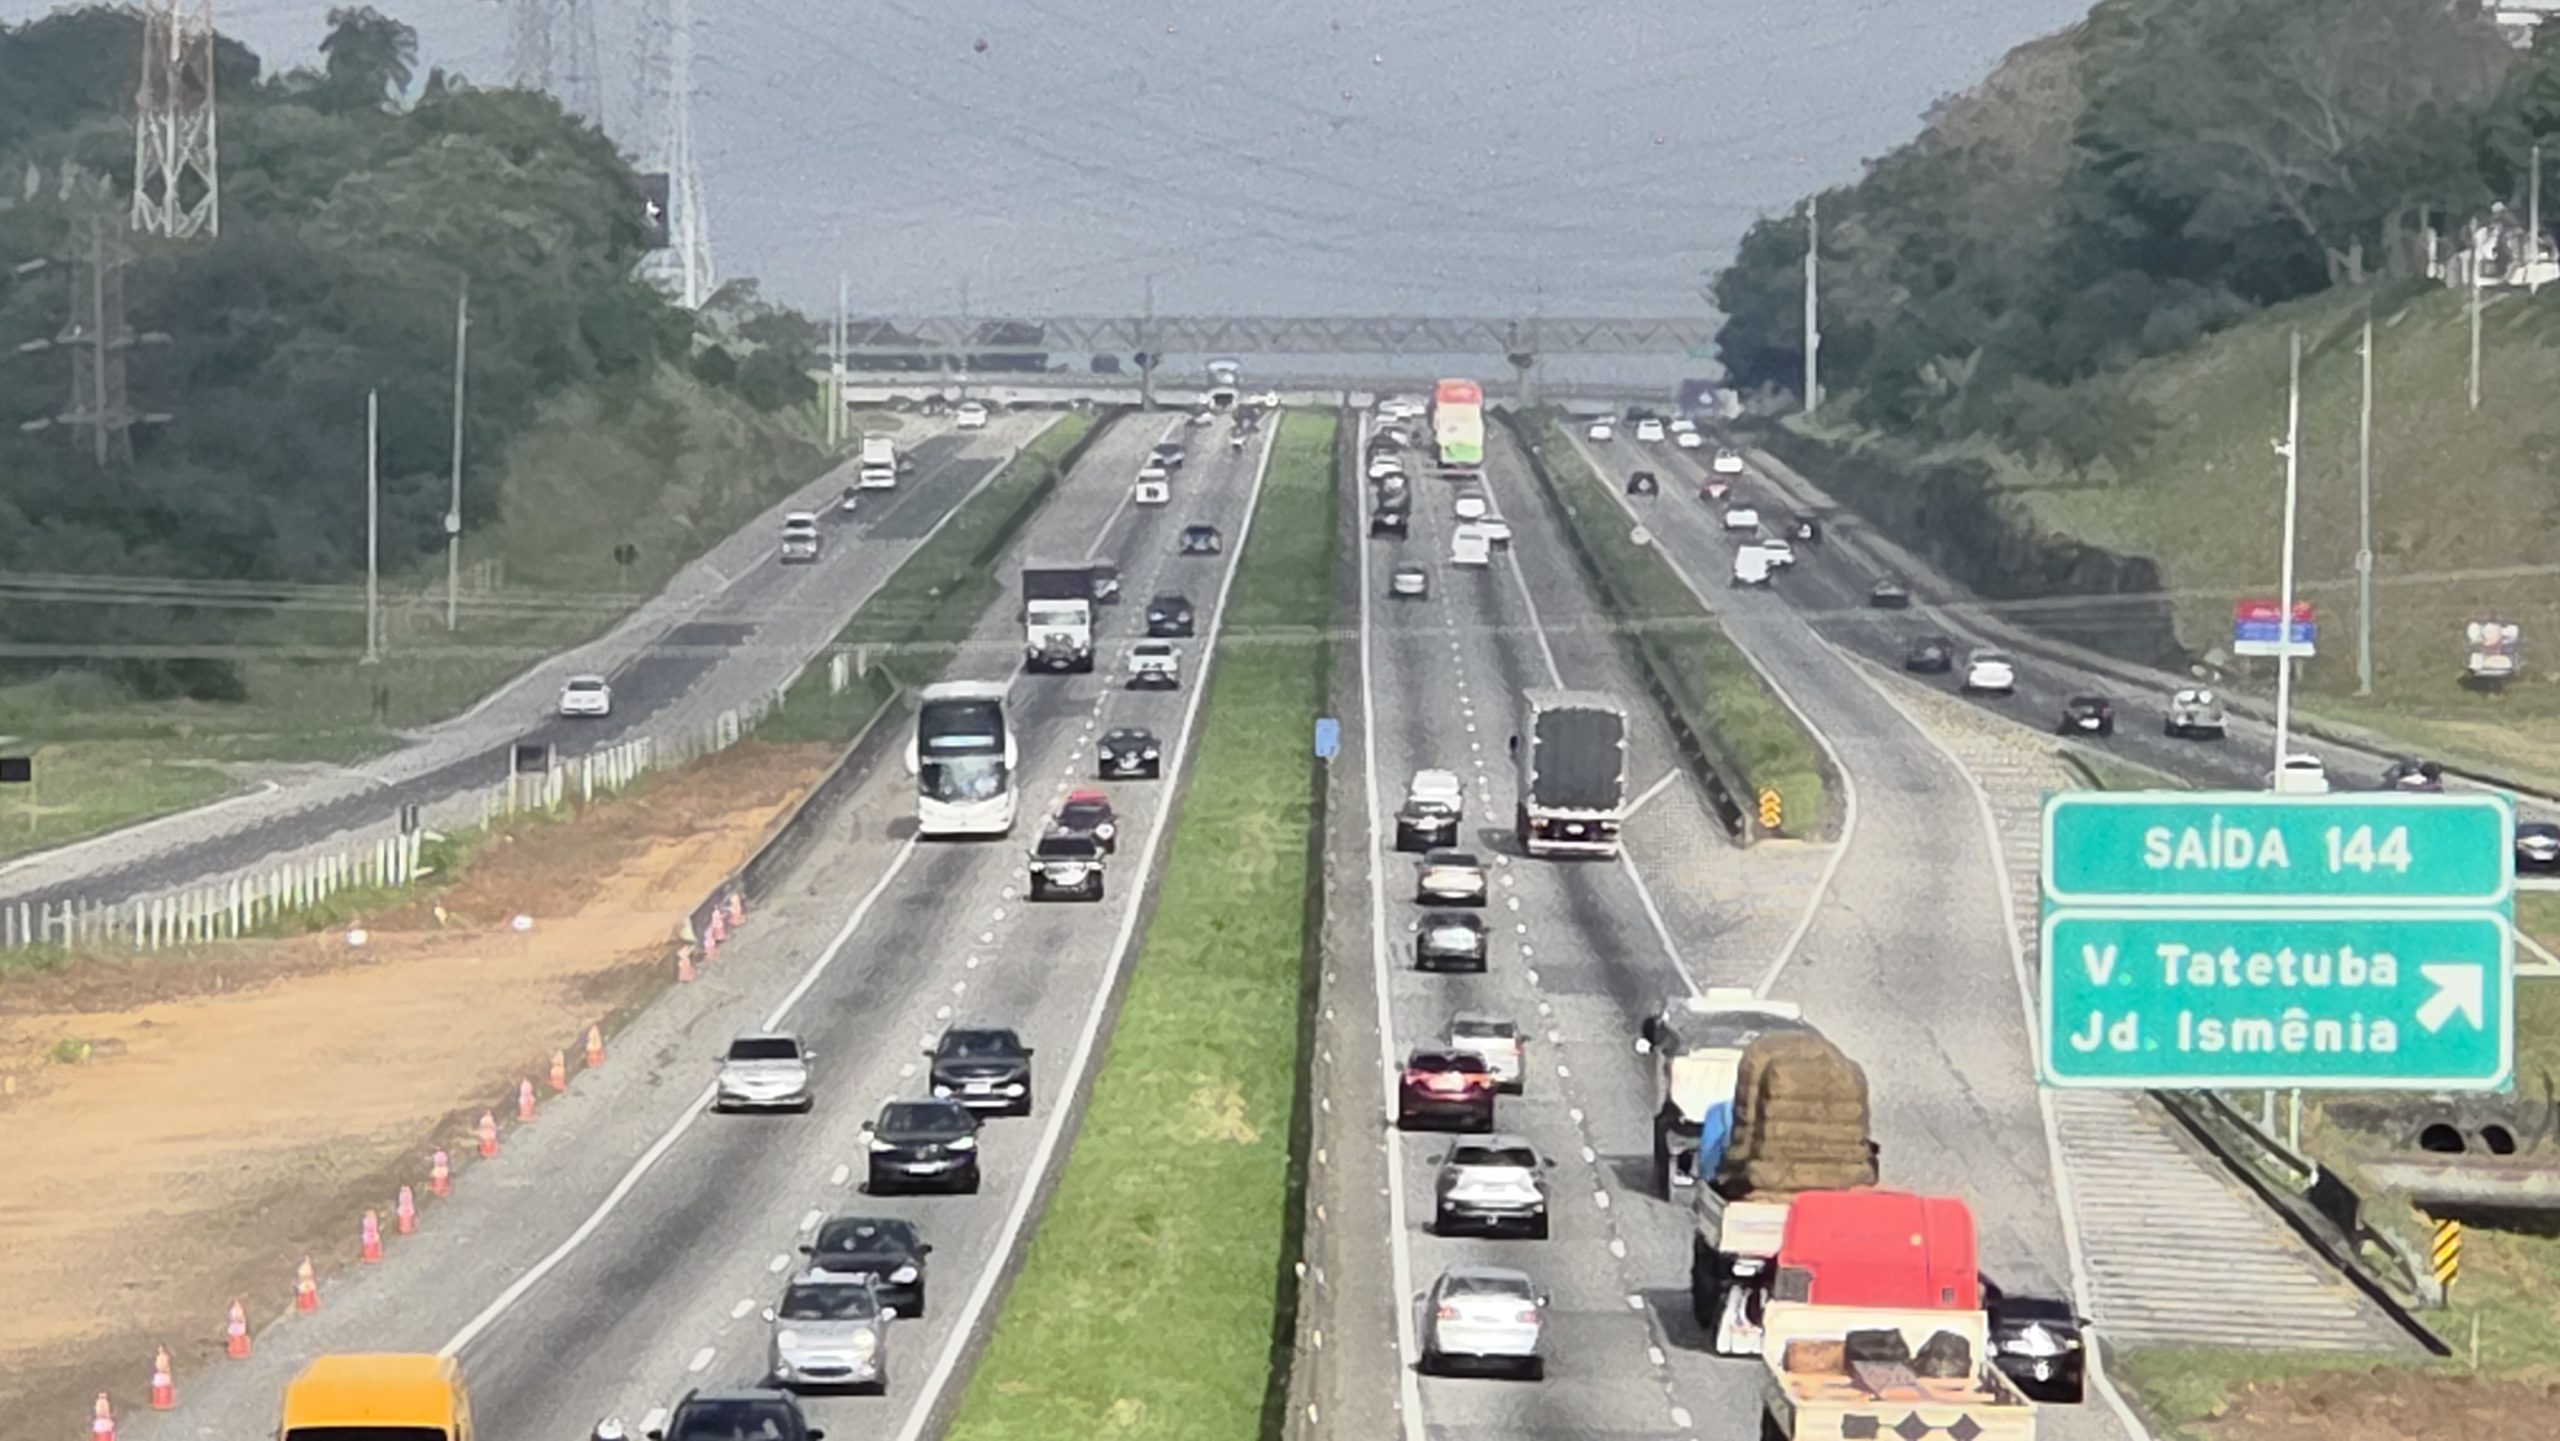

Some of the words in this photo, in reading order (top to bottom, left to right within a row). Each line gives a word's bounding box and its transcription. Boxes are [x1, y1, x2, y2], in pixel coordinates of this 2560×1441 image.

[2143, 813, 2290, 870] SAÍDA
[2324, 824, 2413, 873] 144
[2082, 943, 2132, 986] V.
[2156, 943, 2398, 987] Tatetuba
[2070, 1010, 2158, 1053] Jd.
[2177, 1007, 2398, 1053] Ismênia
